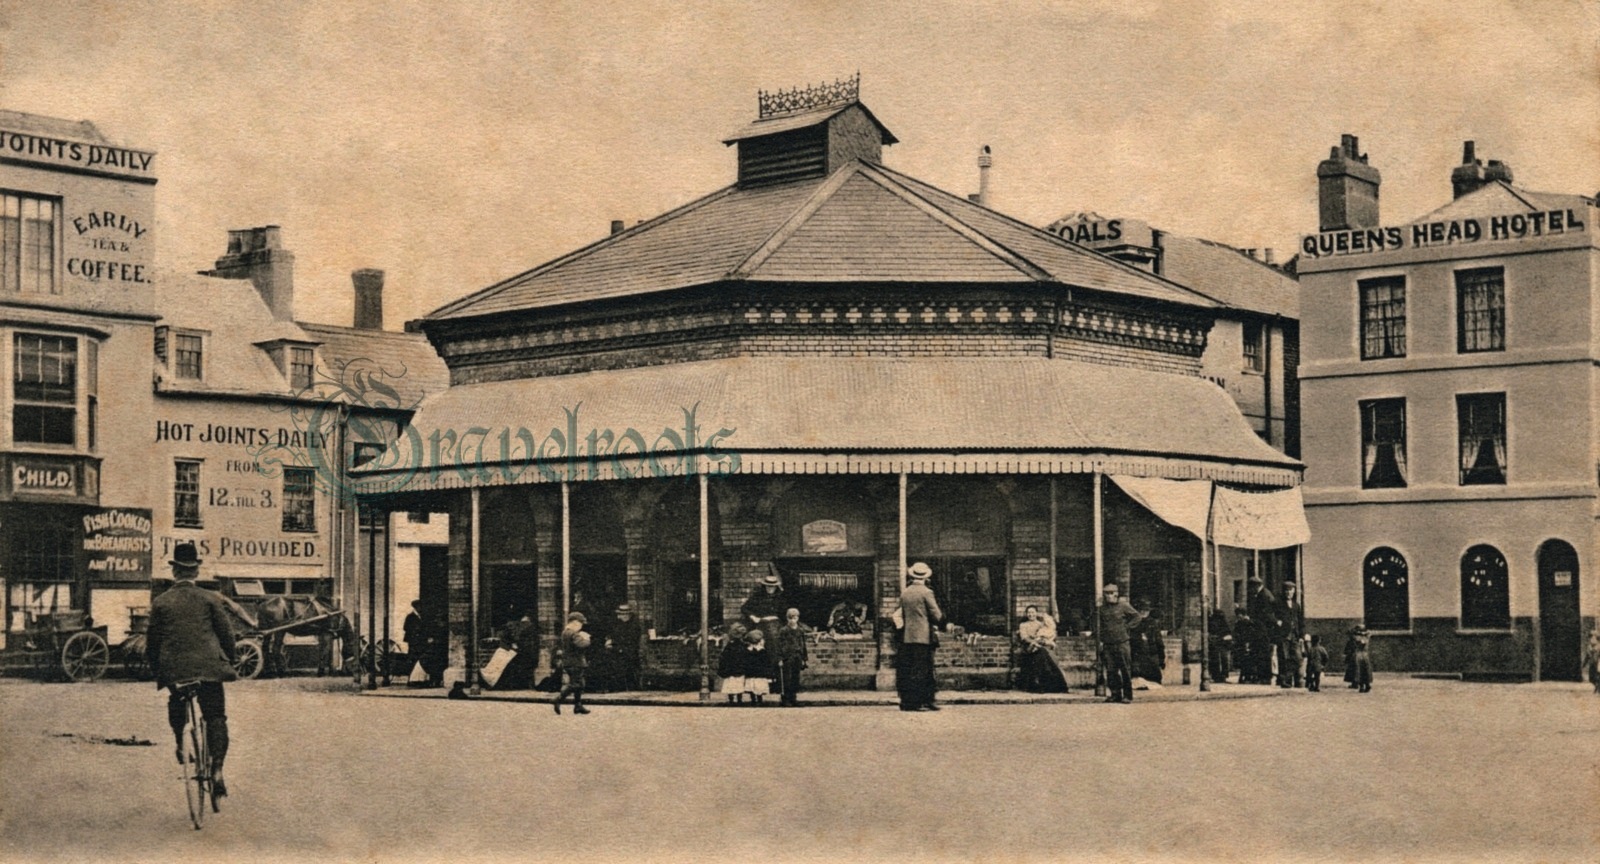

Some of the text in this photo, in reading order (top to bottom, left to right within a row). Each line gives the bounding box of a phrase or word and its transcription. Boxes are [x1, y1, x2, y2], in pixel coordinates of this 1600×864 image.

[86, 145, 152, 171] DAILY
[73, 211, 147, 239] EARLY
[1048, 220, 1122, 243] OALS
[1303, 210, 1584, 258] QUEEN'S HEAD HOTEL
[91, 238, 131, 253] TEA &
[67, 257, 152, 284] COFFEE.
[155, 420, 330, 449] HOT JOINTS DAILY
[225, 458, 261, 476] FROM
[208, 487, 277, 509] 12. TILL 3.
[83, 509, 152, 534] FISH COOKED
[160, 536, 321, 559] TS PROVIDED.
